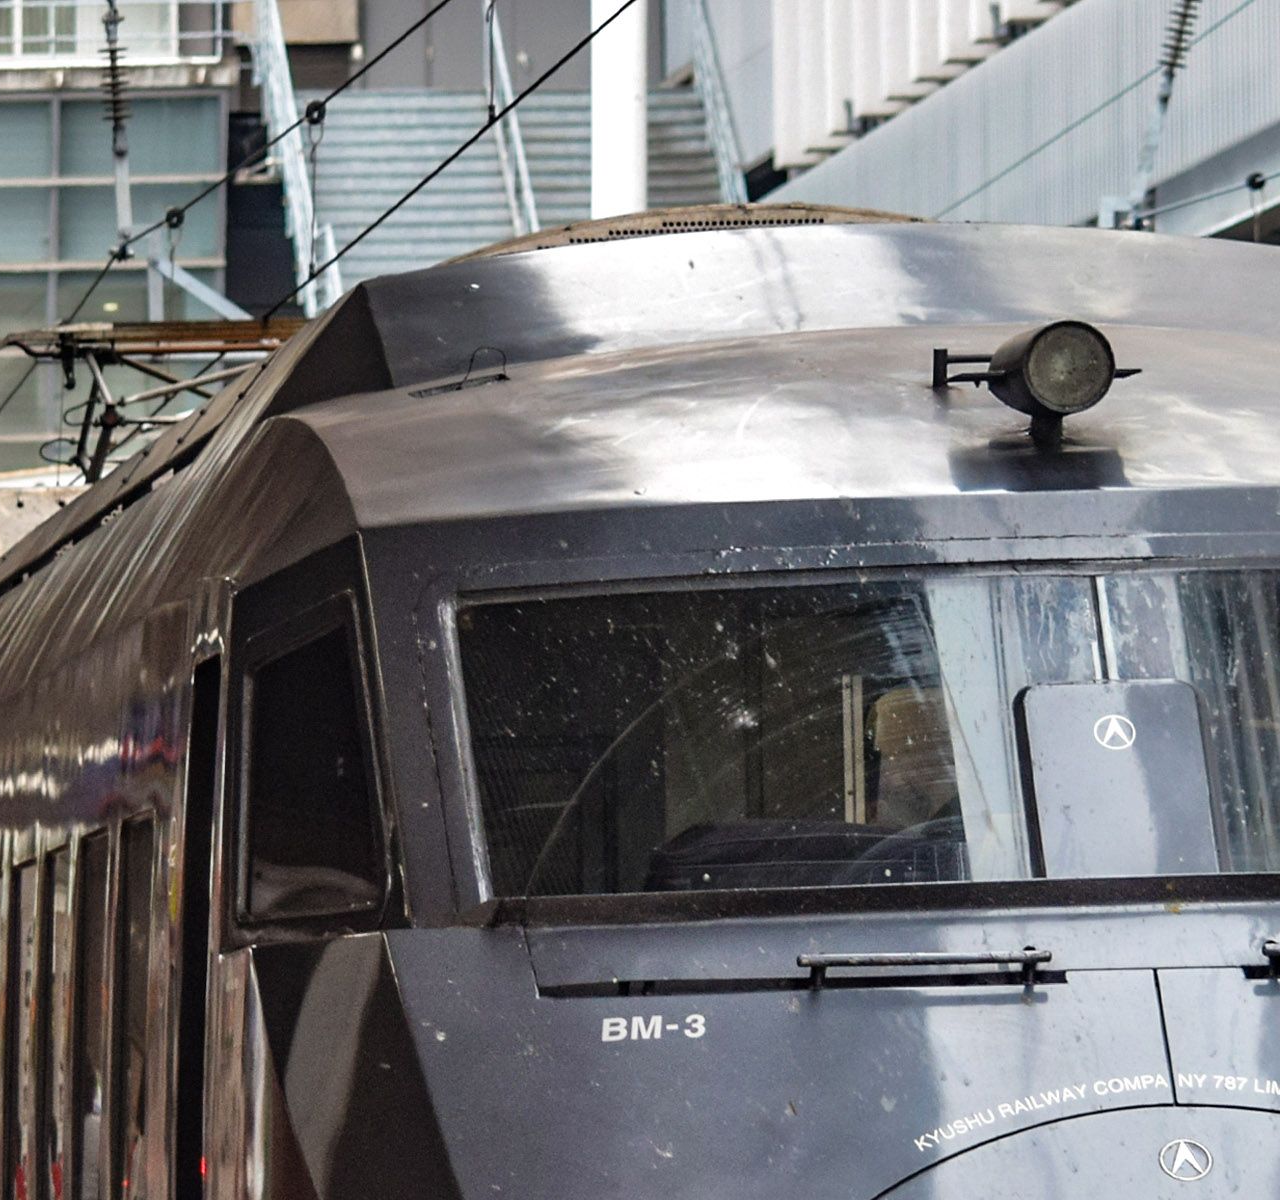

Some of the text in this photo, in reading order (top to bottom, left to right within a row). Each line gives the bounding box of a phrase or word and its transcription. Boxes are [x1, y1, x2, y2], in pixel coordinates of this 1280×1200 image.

[601, 1013, 707, 1042] BM-3
[913, 1108, 996, 1152] KYUSHU
[1000, 1084, 1088, 1119] RAILWAY
[1212, 1074, 1248, 1092] 787
